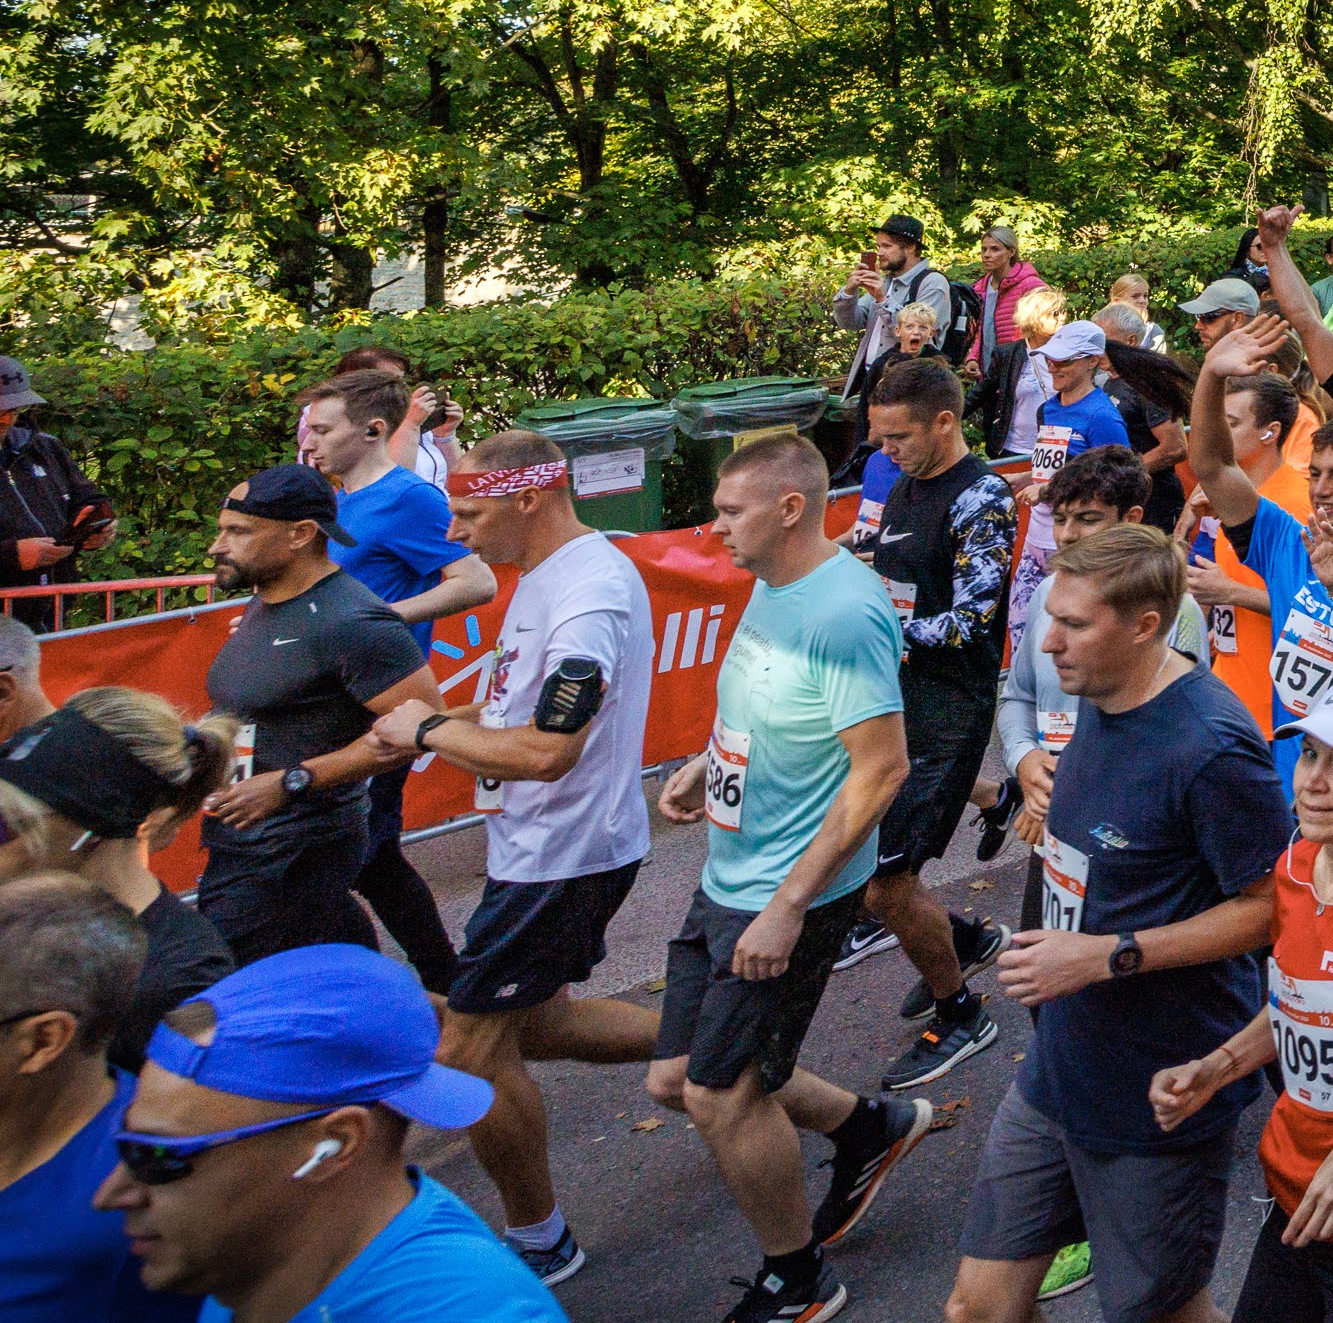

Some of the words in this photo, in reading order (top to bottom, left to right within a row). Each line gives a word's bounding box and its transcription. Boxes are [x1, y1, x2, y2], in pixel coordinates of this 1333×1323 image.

[1033, 448, 1064, 470] 2068
[1318, 1014, 1331, 1028] 10
[1320, 1092, 1332, 1101] 57
